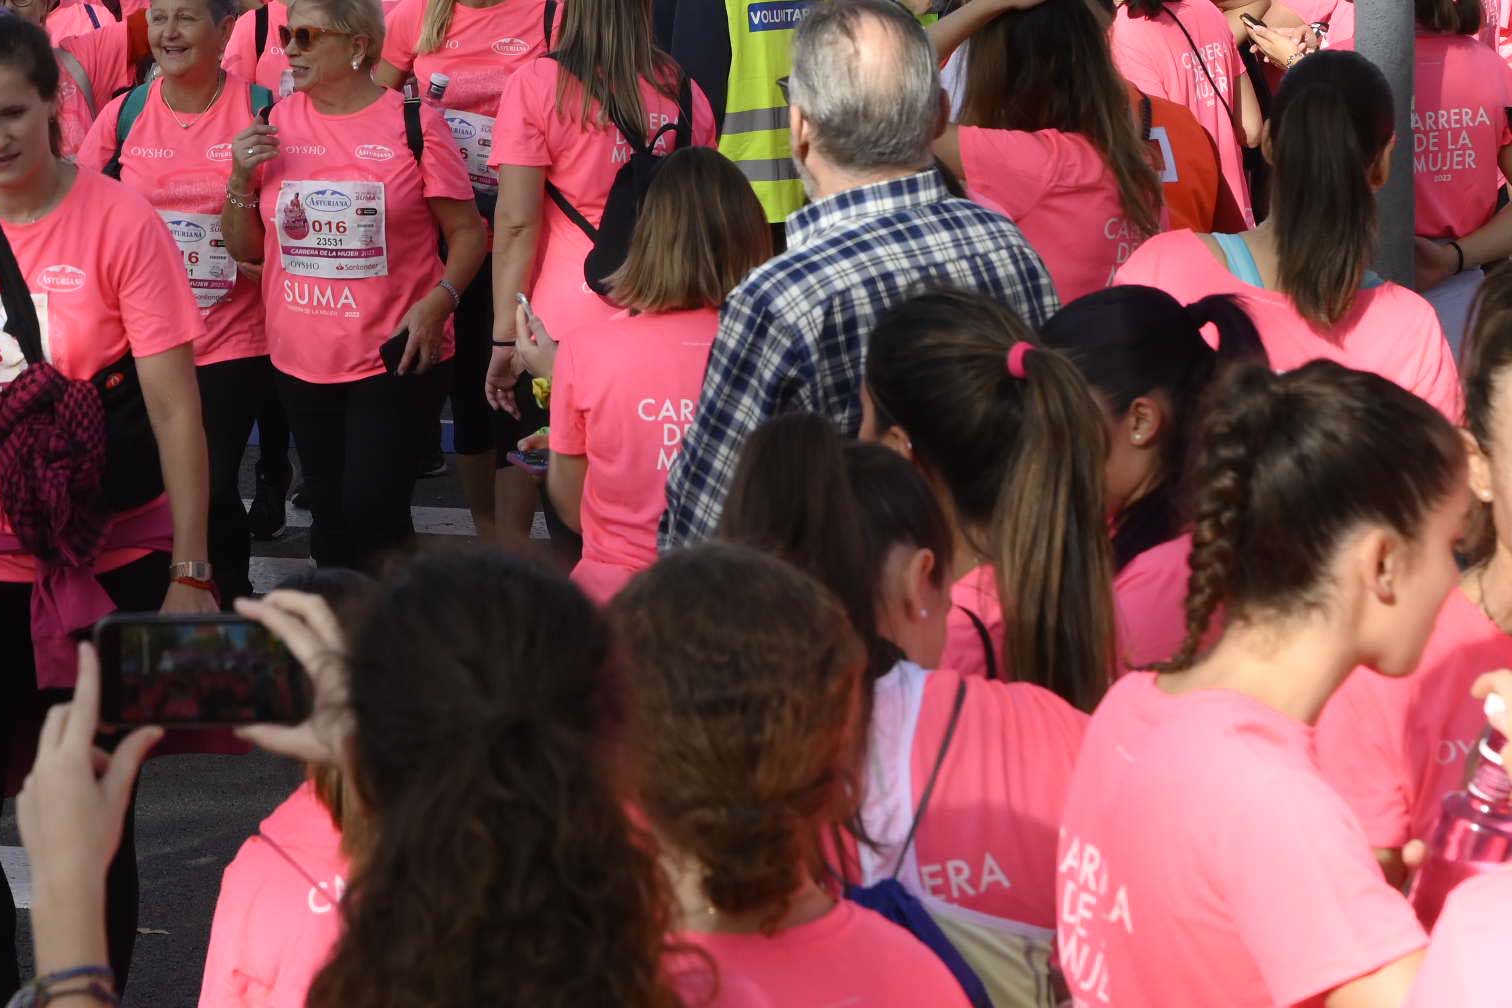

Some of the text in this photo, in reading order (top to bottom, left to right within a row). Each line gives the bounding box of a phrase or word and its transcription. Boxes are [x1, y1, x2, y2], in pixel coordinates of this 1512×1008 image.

[1410, 105, 1491, 130] ARRERA
[130, 146, 174, 159] OYSHO
[1413, 130, 1473, 153] DE LA
[1413, 150, 1477, 174] MUJER
[311, 220, 348, 235] 016
[316, 237, 344, 247] 23531
[283, 279, 357, 309] SUMA
